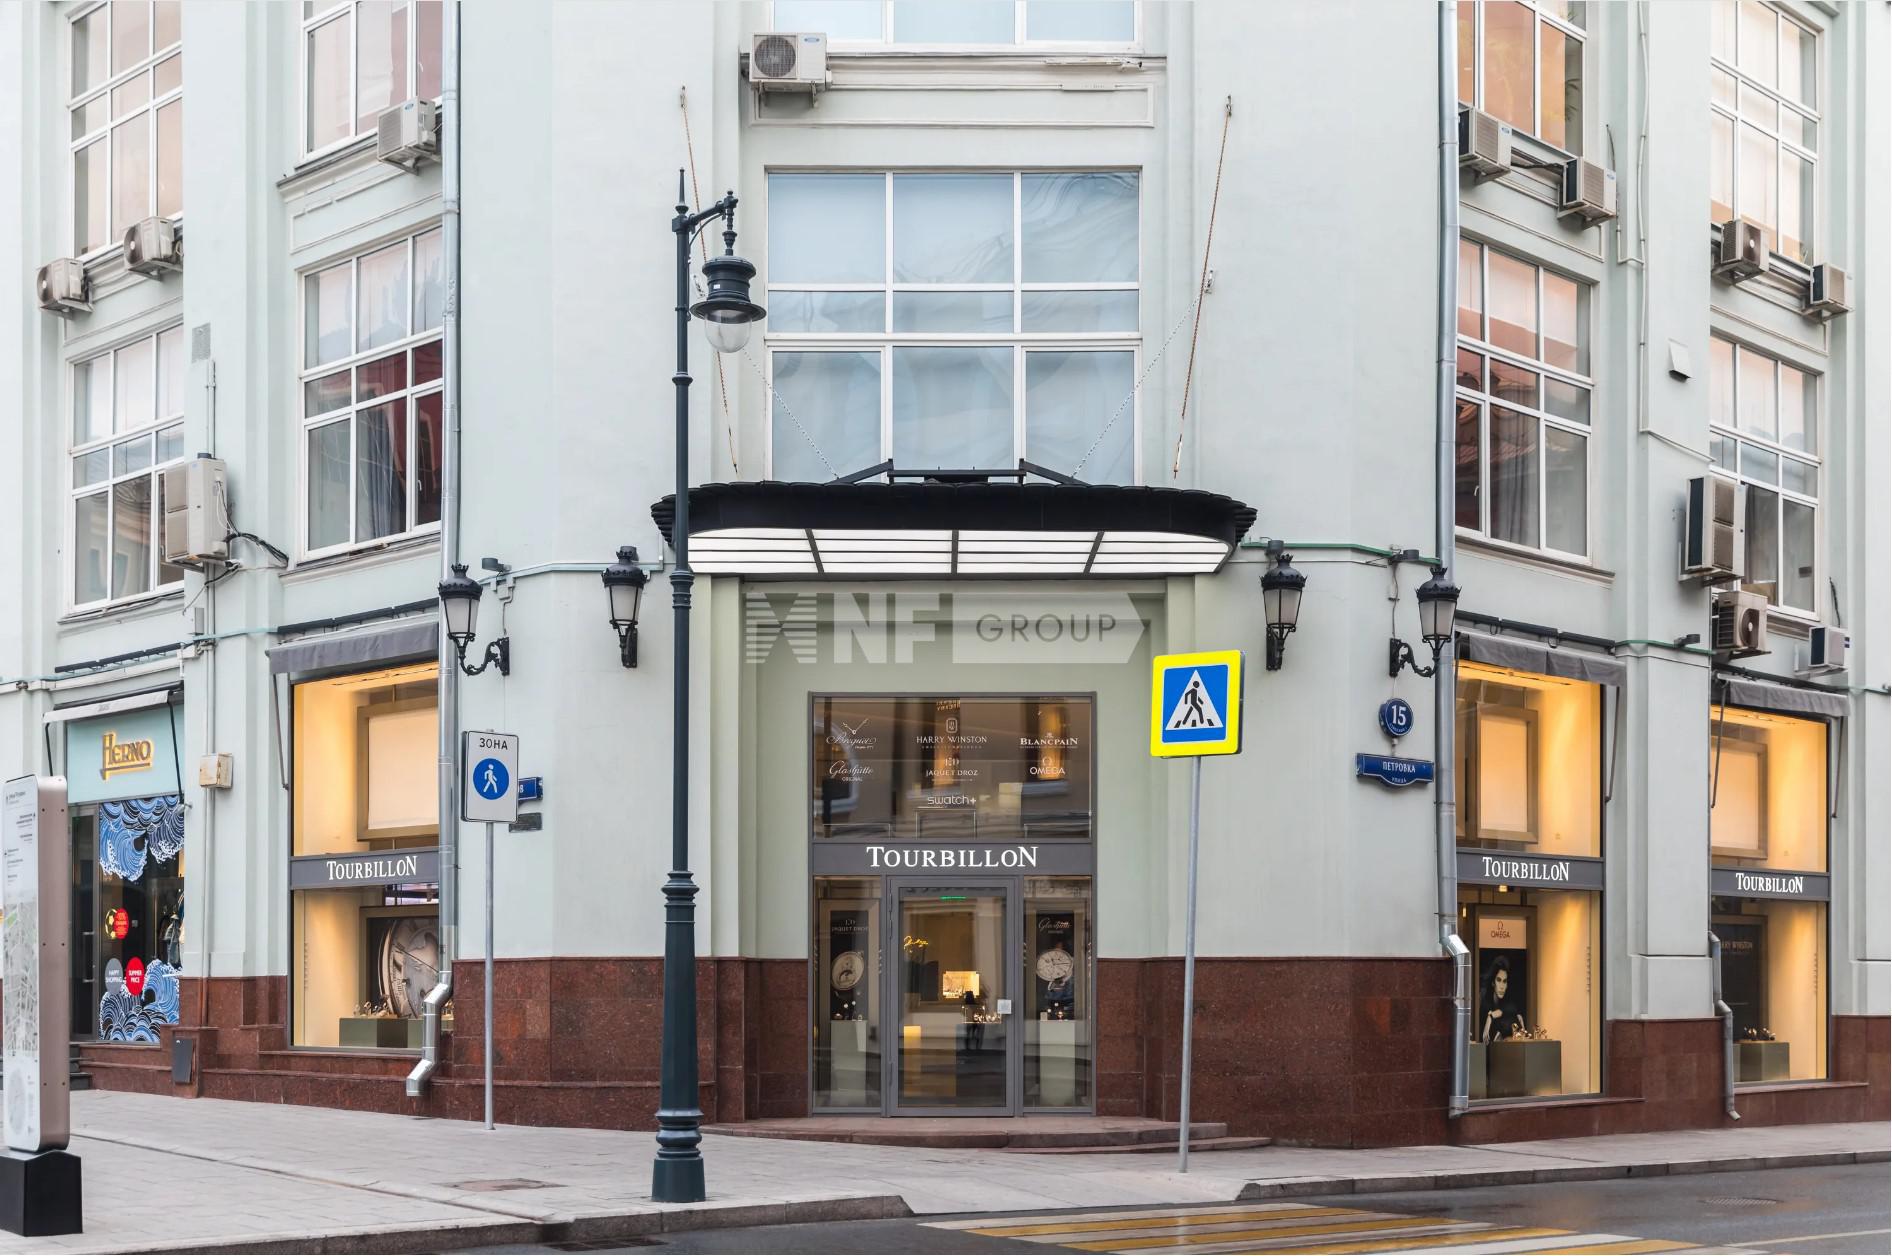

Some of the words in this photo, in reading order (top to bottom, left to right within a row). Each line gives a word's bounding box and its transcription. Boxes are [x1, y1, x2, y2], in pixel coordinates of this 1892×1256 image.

[1391, 705, 1407, 726] 15
[479, 738, 508, 750] ЗОНА
[916, 735, 945, 744] HARRY
[947, 735, 987, 744] WINSTON
[1020, 737, 1079, 745] BLANCPAIN
[101, 733, 152, 780] HERNO
[926, 769, 955, 777] JAQUET
[957, 769, 978, 777] DROZ
[1029, 766, 1066, 775] OMEGA
[1382, 761, 1416, 773] ПЕТРОВКА
[866, 846, 1039, 868] TOURBILLON
[326, 855, 418, 880] TOURBILLON
[1482, 856, 1569, 882] TOURBILLON
[1736, 873, 1804, 894] TOURBILLON
[1490, 930, 1511, 939] OMEGA
